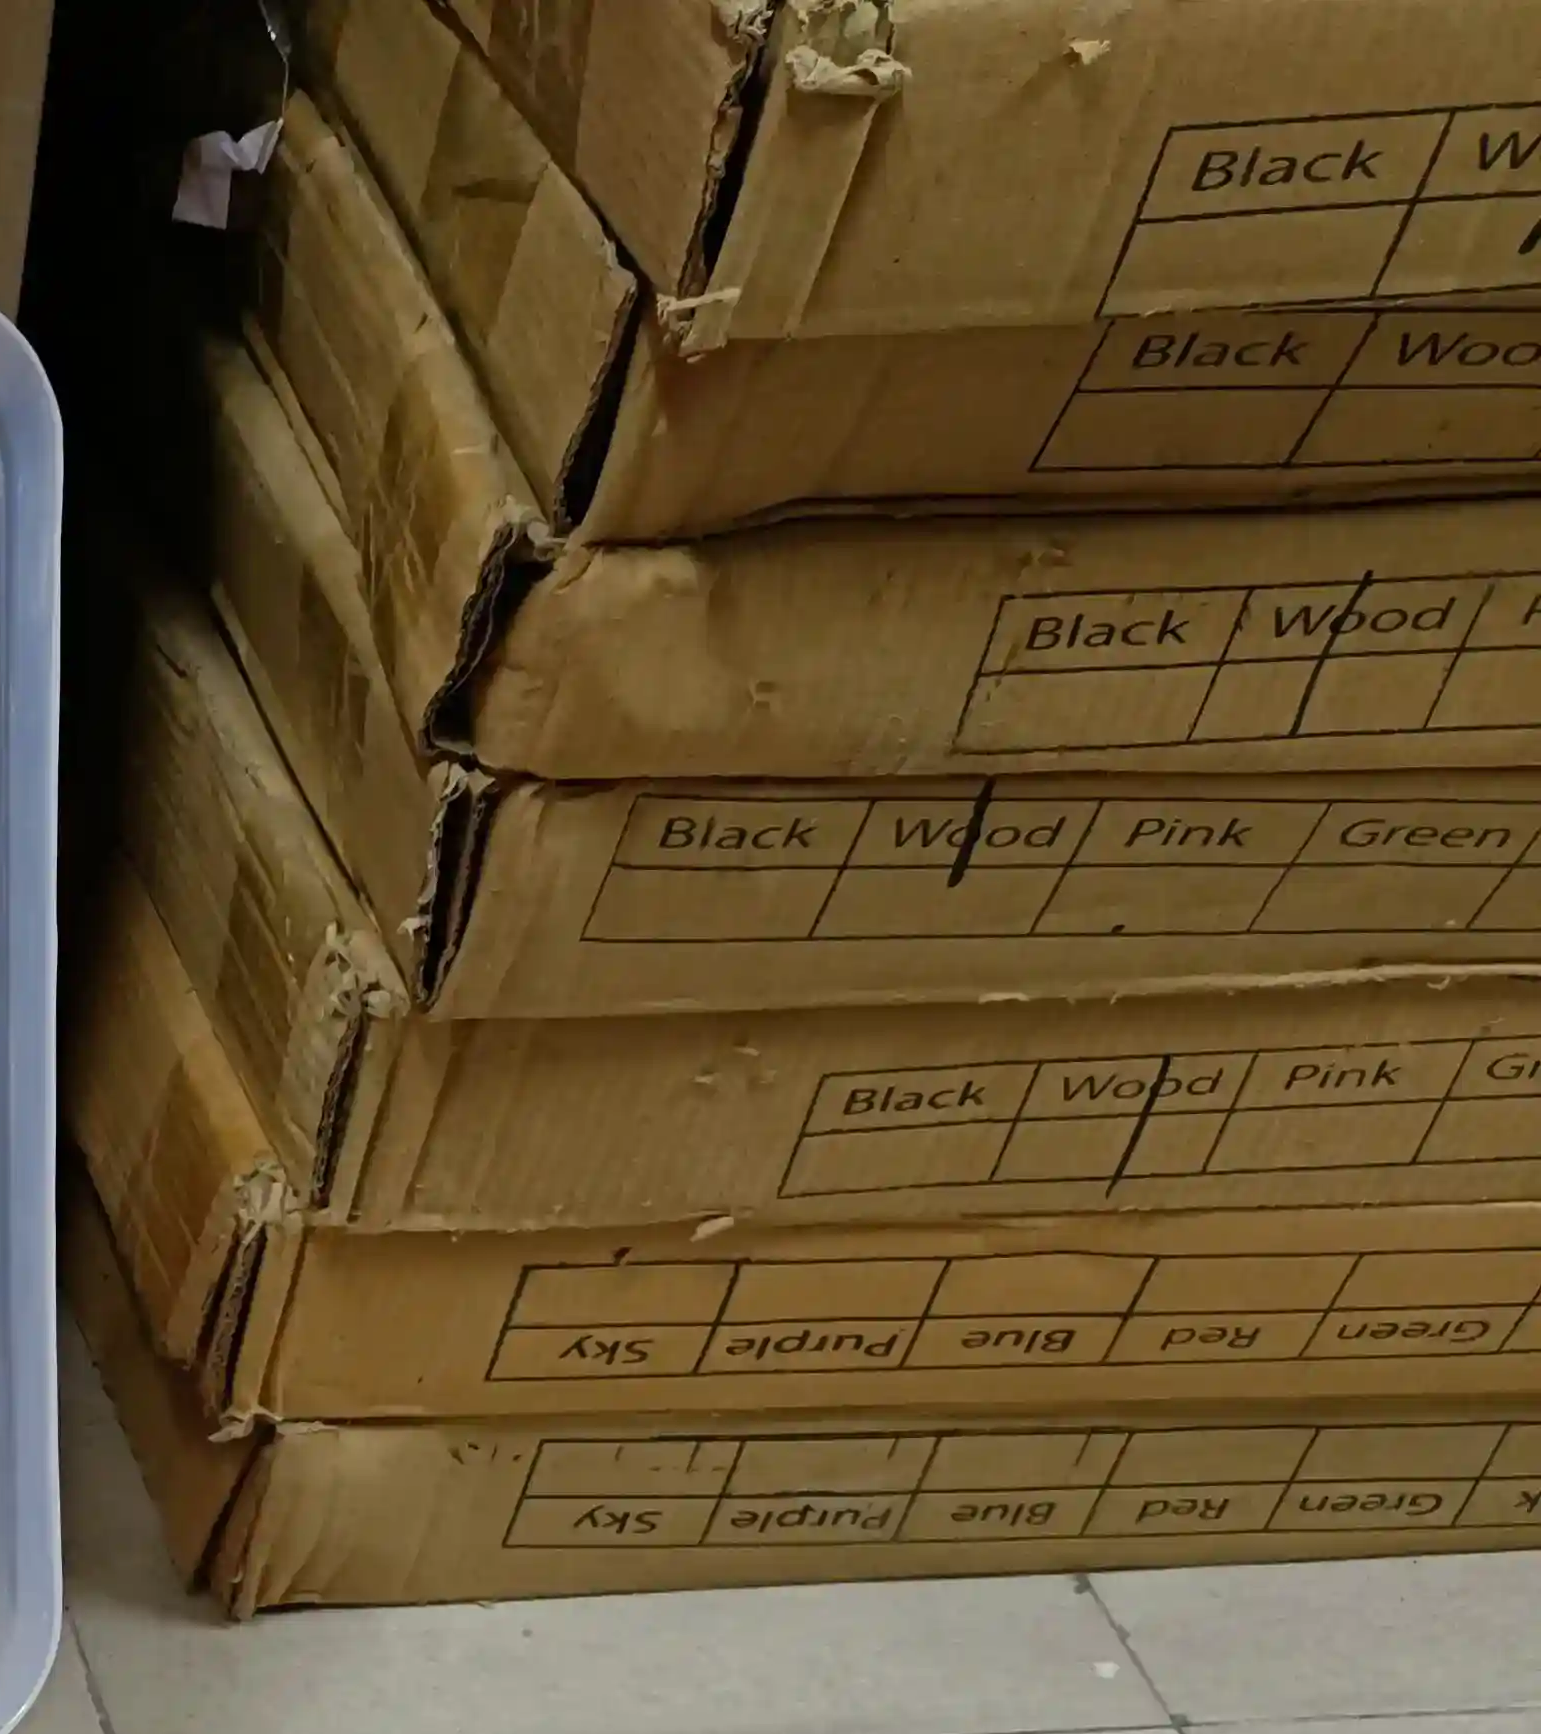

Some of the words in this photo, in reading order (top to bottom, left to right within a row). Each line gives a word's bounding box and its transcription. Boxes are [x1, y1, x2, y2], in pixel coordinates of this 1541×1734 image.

[1192, 140, 1383, 192] Black
[1132, 332, 1307, 370] Black
[1398, 331, 1541, 366] Woo
[1025, 610, 1192, 652] Black
[1272, 597, 1457, 641] Wood
[658, 816, 818, 852] Black
[891, 815, 1065, 850] Wood
[1125, 815, 1253, 850] Pink
[1340, 818, 1512, 848] Green
[843, 1081, 987, 1118] Black
[1060, 1067, 1224, 1103] Wood
[1283, 1057, 1401, 1093] Pink
[726, 1326, 904, 1361] Purple
[961, 1327, 1075, 1354] Blue
[1161, 1323, 1263, 1352] Red
[1338, 1318, 1491, 1348] Green
[559, 1335, 655, 1363] Sky
[731, 1502, 892, 1533] Purple
[951, 1498, 1055, 1527] Blue
[1138, 1495, 1230, 1523] Red
[1298, 1490, 1444, 1518] Green
[573, 1506, 659, 1535] Sky
